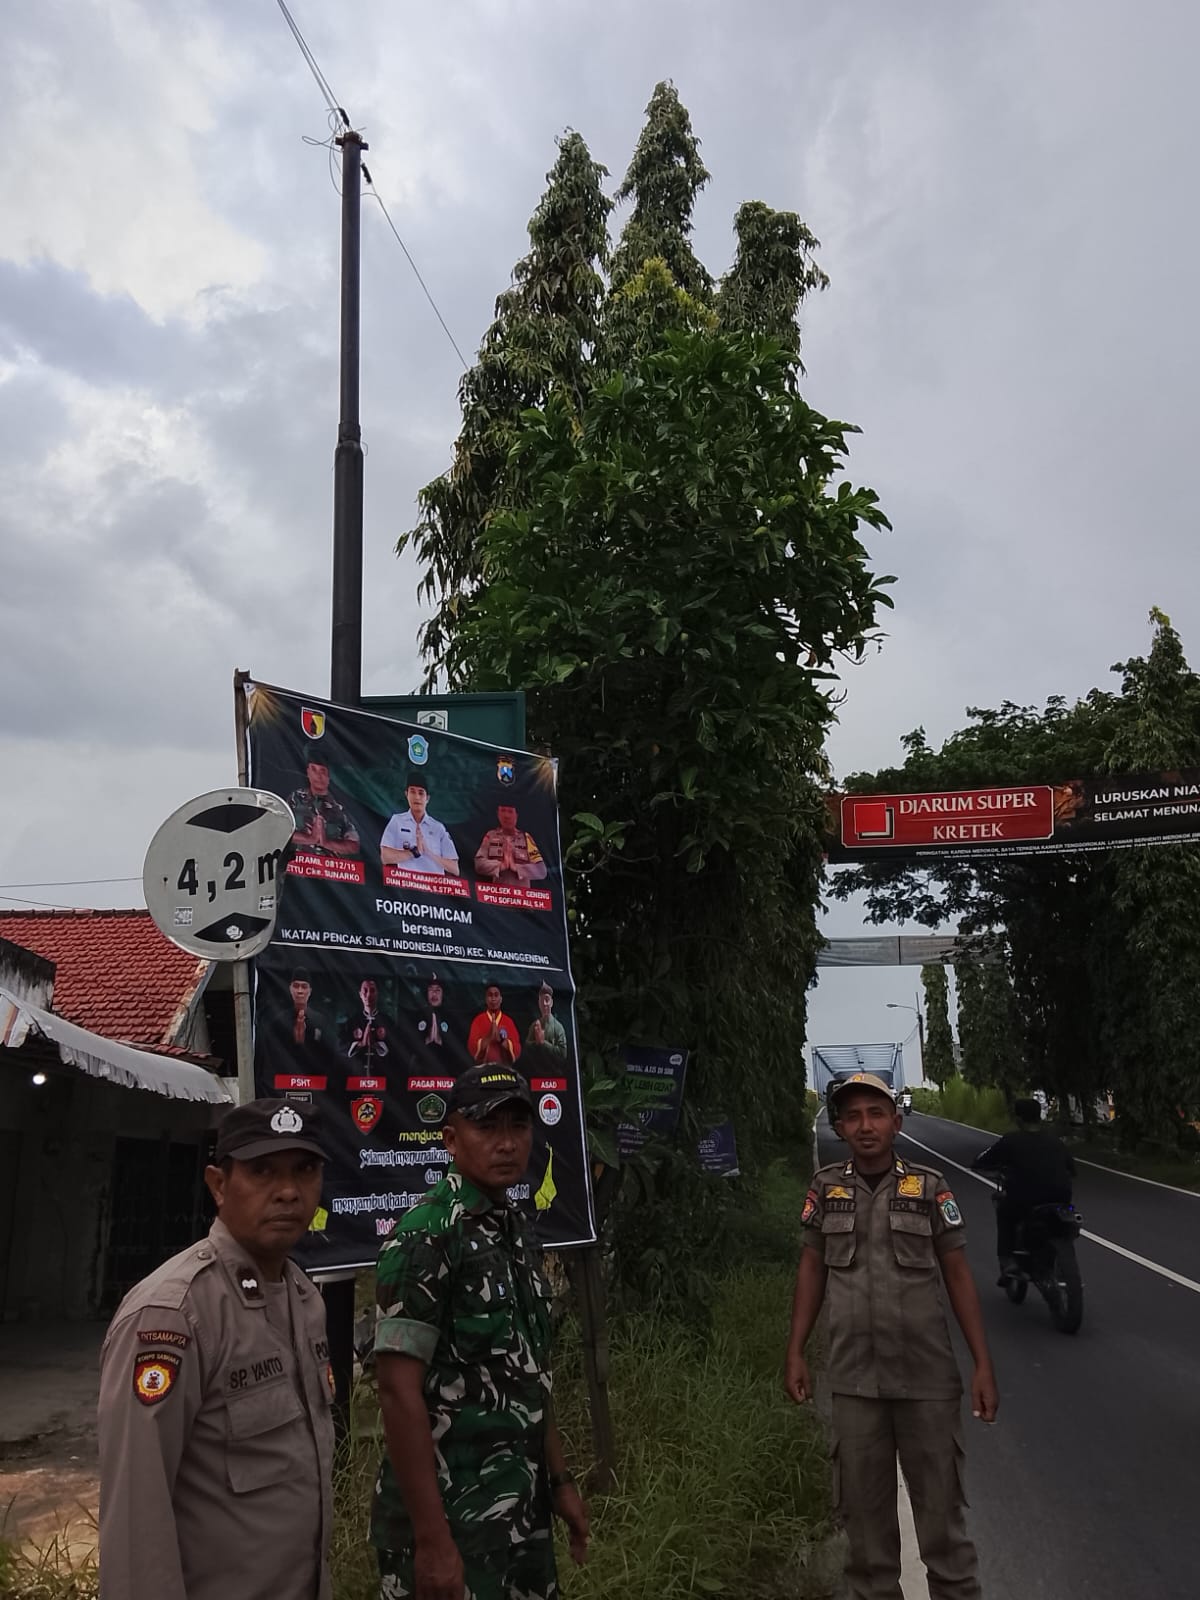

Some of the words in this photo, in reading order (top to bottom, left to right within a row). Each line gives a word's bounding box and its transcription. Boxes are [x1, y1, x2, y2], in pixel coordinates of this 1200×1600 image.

[900, 797, 973, 815] DJARUM
[976, 792, 1037, 810] SUPER
[1094, 788, 1169, 804] LURUSKAN
[1094, 808, 1149, 822] SELAMAT
[933, 822, 1004, 840] KRETEK
[296, 855, 322, 866] RAMIL
[177, 851, 246, 903] 4,2
[257, 848, 282, 885] m
[286, 864, 304, 874] ETTU
[324, 870, 360, 881] SUNARKO
[477, 885, 511, 895] KAPOLSEK
[483, 894, 498, 903] IPTU
[498, 897, 522, 905] SOFIAN
[375, 898, 473, 925] FORKOPIMCAM
[402, 920, 452, 938] bersama
[281, 929, 320, 941] IKATAN
[323, 931, 363, 945] PENCAK
[365, 935, 391, 948] SILAT
[392, 939, 442, 953] INDONESIA
[442, 944, 466, 957] (IPSI)
[467, 948, 486, 957] KEC.
[487, 949, 550, 965] KARANGGENENG
[290, 1078, 312, 1088] PSHT
[410, 1079, 435, 1089] PAGAR
[540, 1081, 558, 1090] ASAD
[398, 1129, 443, 1144] menguca
[360, 1149, 395, 1168] Selamat
[424, 1168, 442, 1184] dan
[332, 1193, 388, 1215] menyambut
[388, 1191, 408, 1211] hari
[251, 1356, 283, 1382] YANTO
